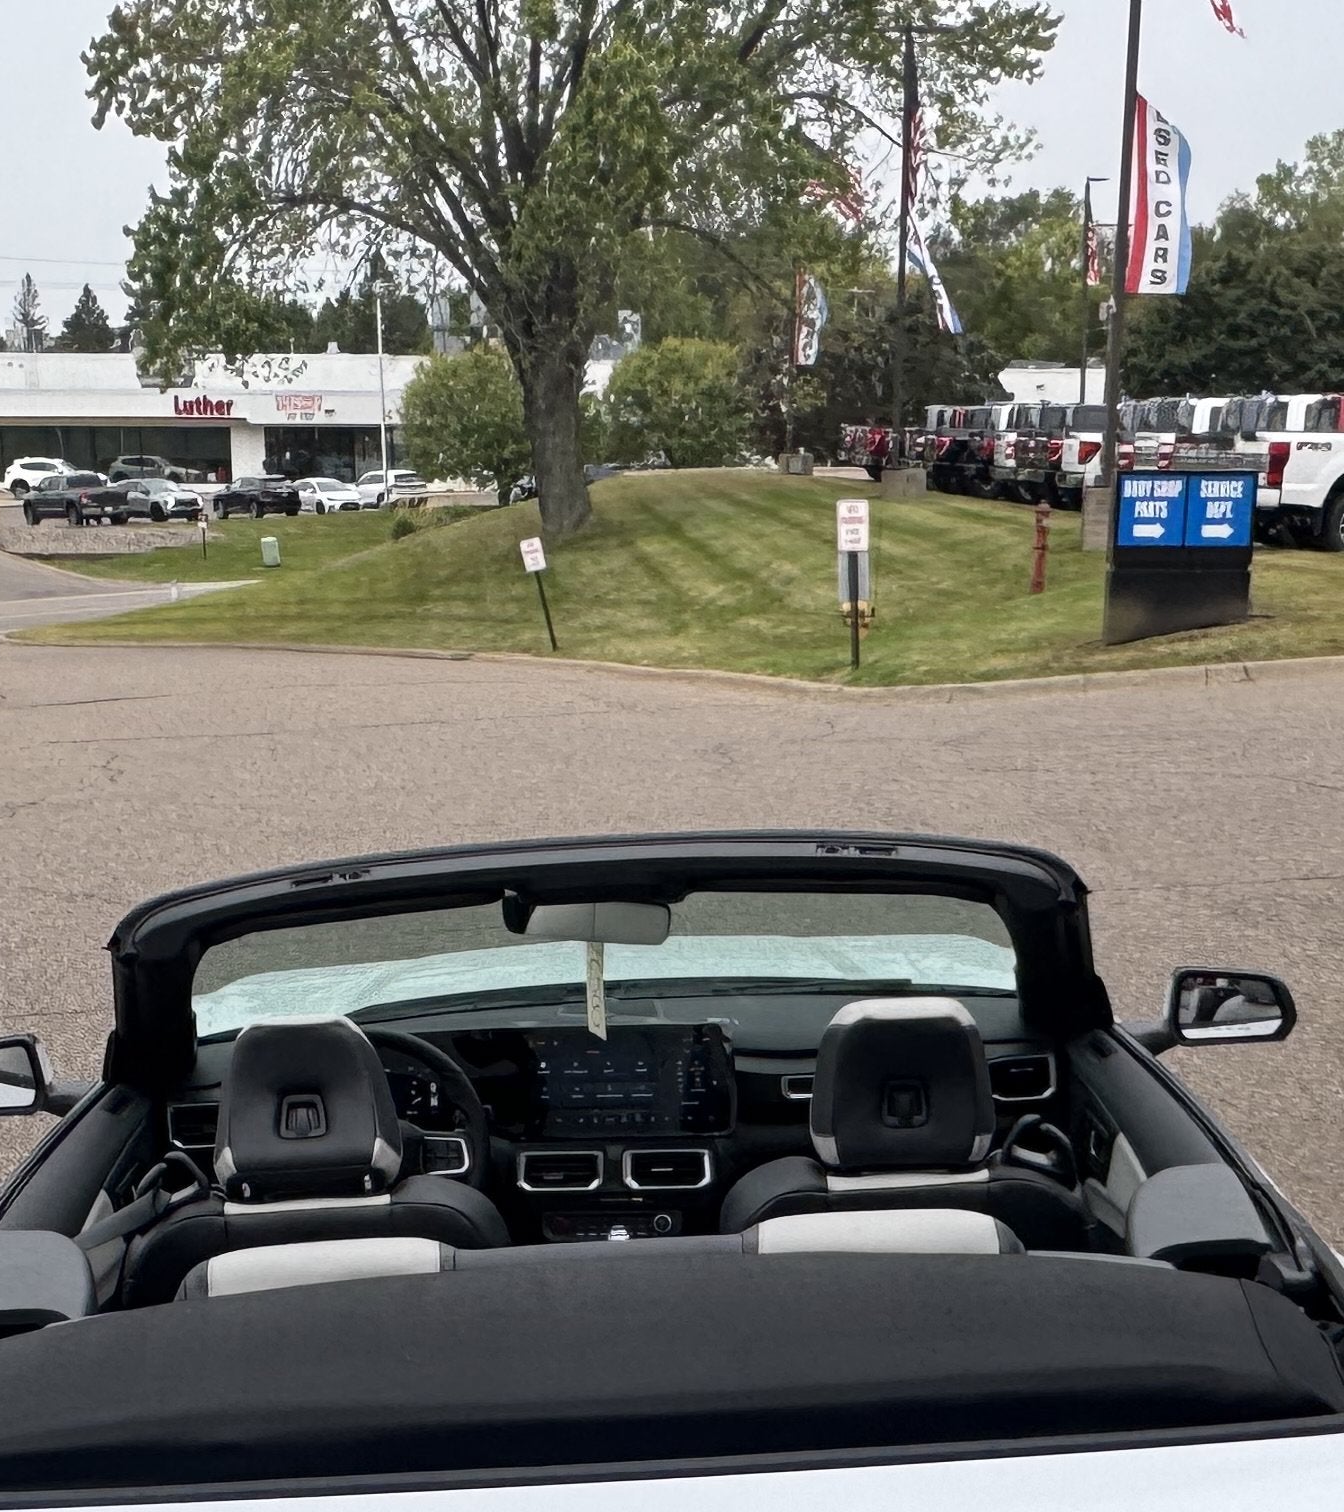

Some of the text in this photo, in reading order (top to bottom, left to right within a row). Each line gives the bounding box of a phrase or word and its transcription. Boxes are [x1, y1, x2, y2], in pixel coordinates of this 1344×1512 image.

[1148, 200, 1173, 286] CARS
[173, 394, 234, 416] Luther
[1199, 479, 1245, 498] SERVICE
